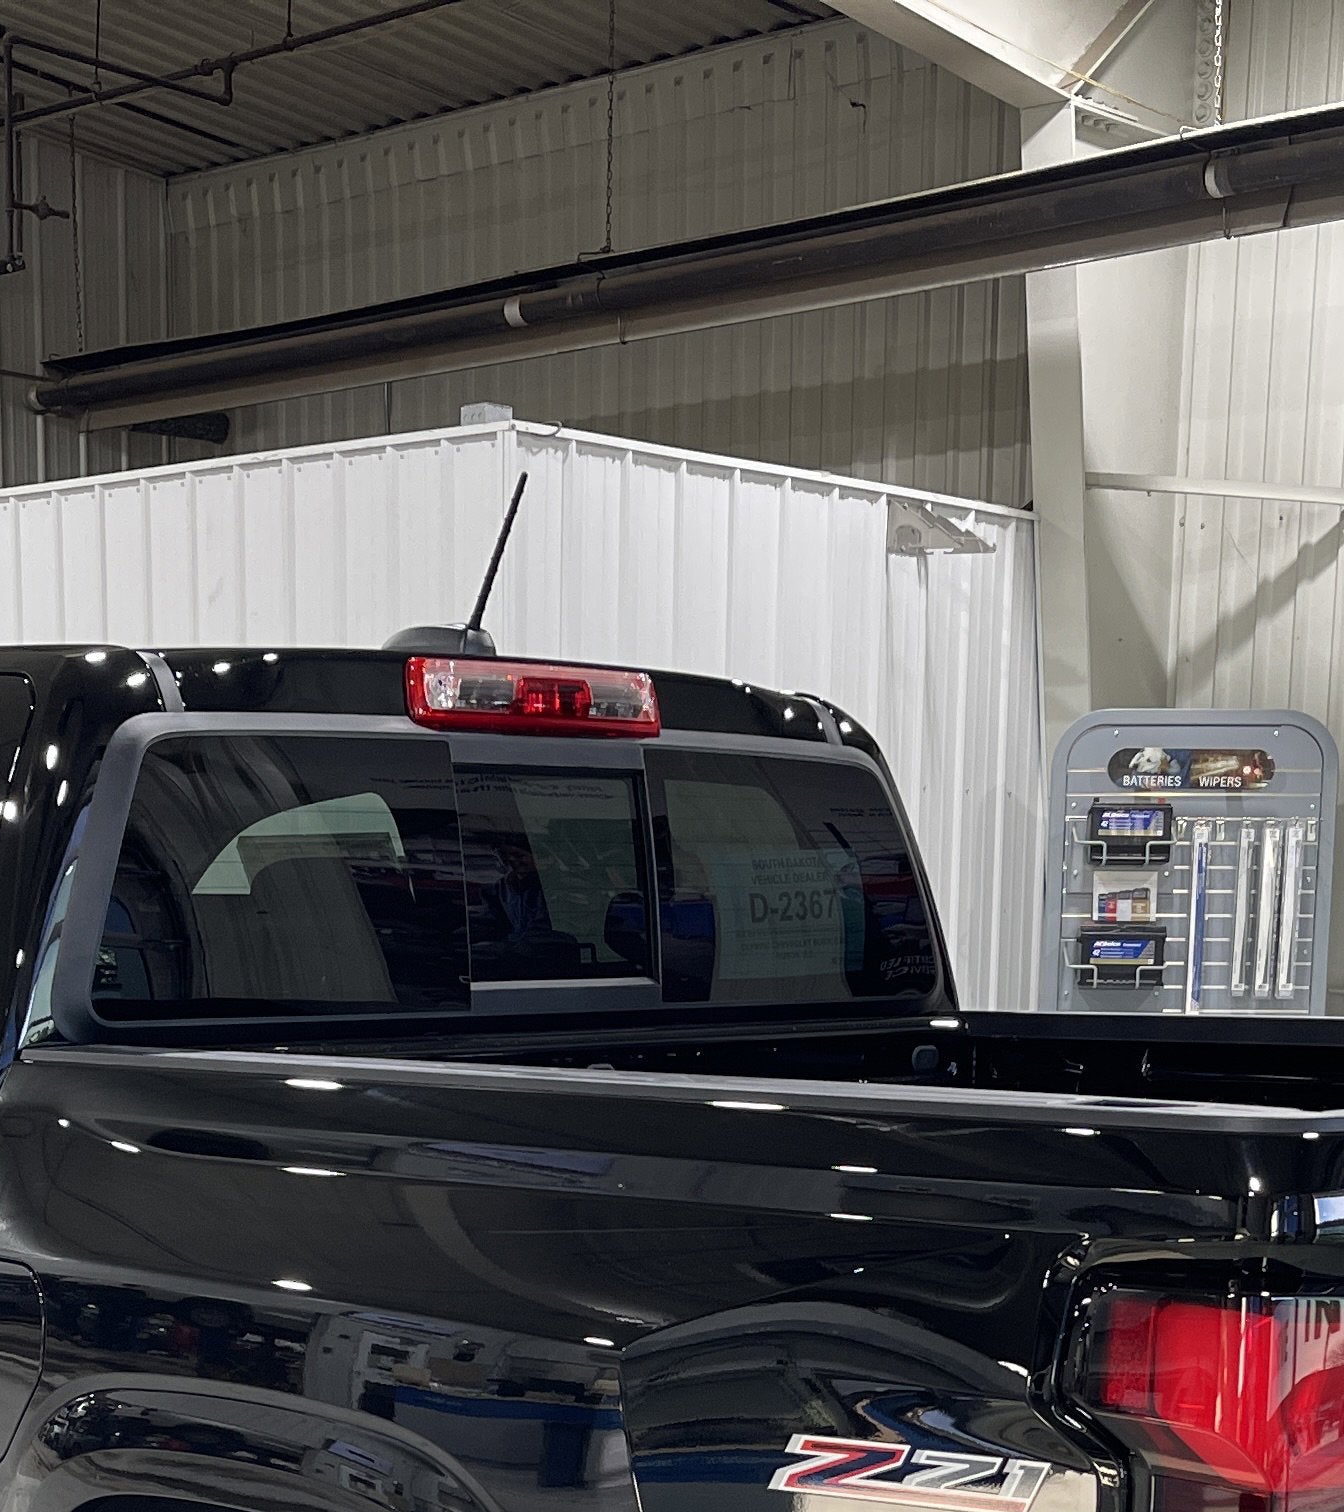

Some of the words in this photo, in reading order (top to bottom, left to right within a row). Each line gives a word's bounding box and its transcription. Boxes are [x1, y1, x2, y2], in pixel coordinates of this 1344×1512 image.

[1122, 775, 1182, 787] BATTERIES
[1198, 776, 1242, 788] WIPERS
[750, 890, 836, 923] D-2367
